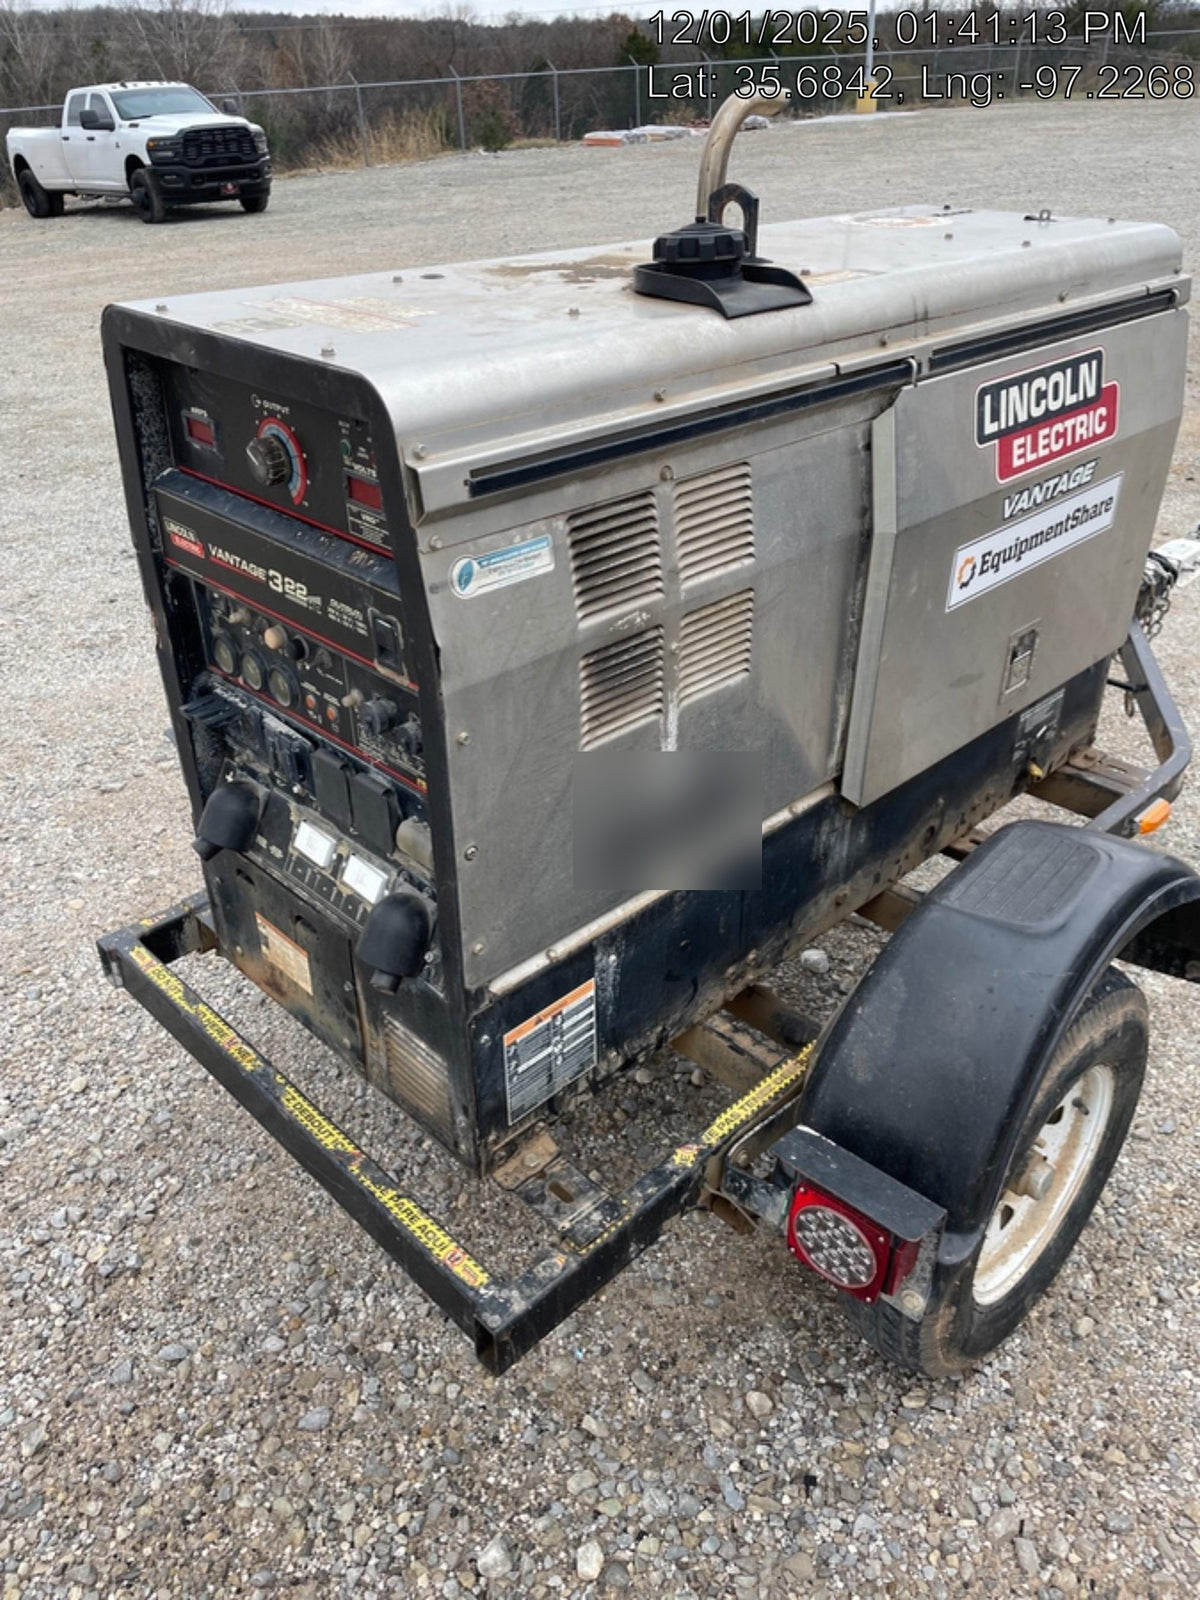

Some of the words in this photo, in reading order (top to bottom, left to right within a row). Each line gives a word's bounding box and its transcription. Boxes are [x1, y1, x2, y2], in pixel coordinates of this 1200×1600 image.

[983, 359, 1098, 436] LINCOLN
[1011, 406, 1108, 469] ELECTRIC
[1002, 460, 1099, 521] VANTAGE
[208, 543, 267, 581] VANTAGE
[977, 495, 1114, 575] EquipmentShare
[292, 1101, 335, 1138] DEBOUT
[388, 1192, 420, 1225] PARE
